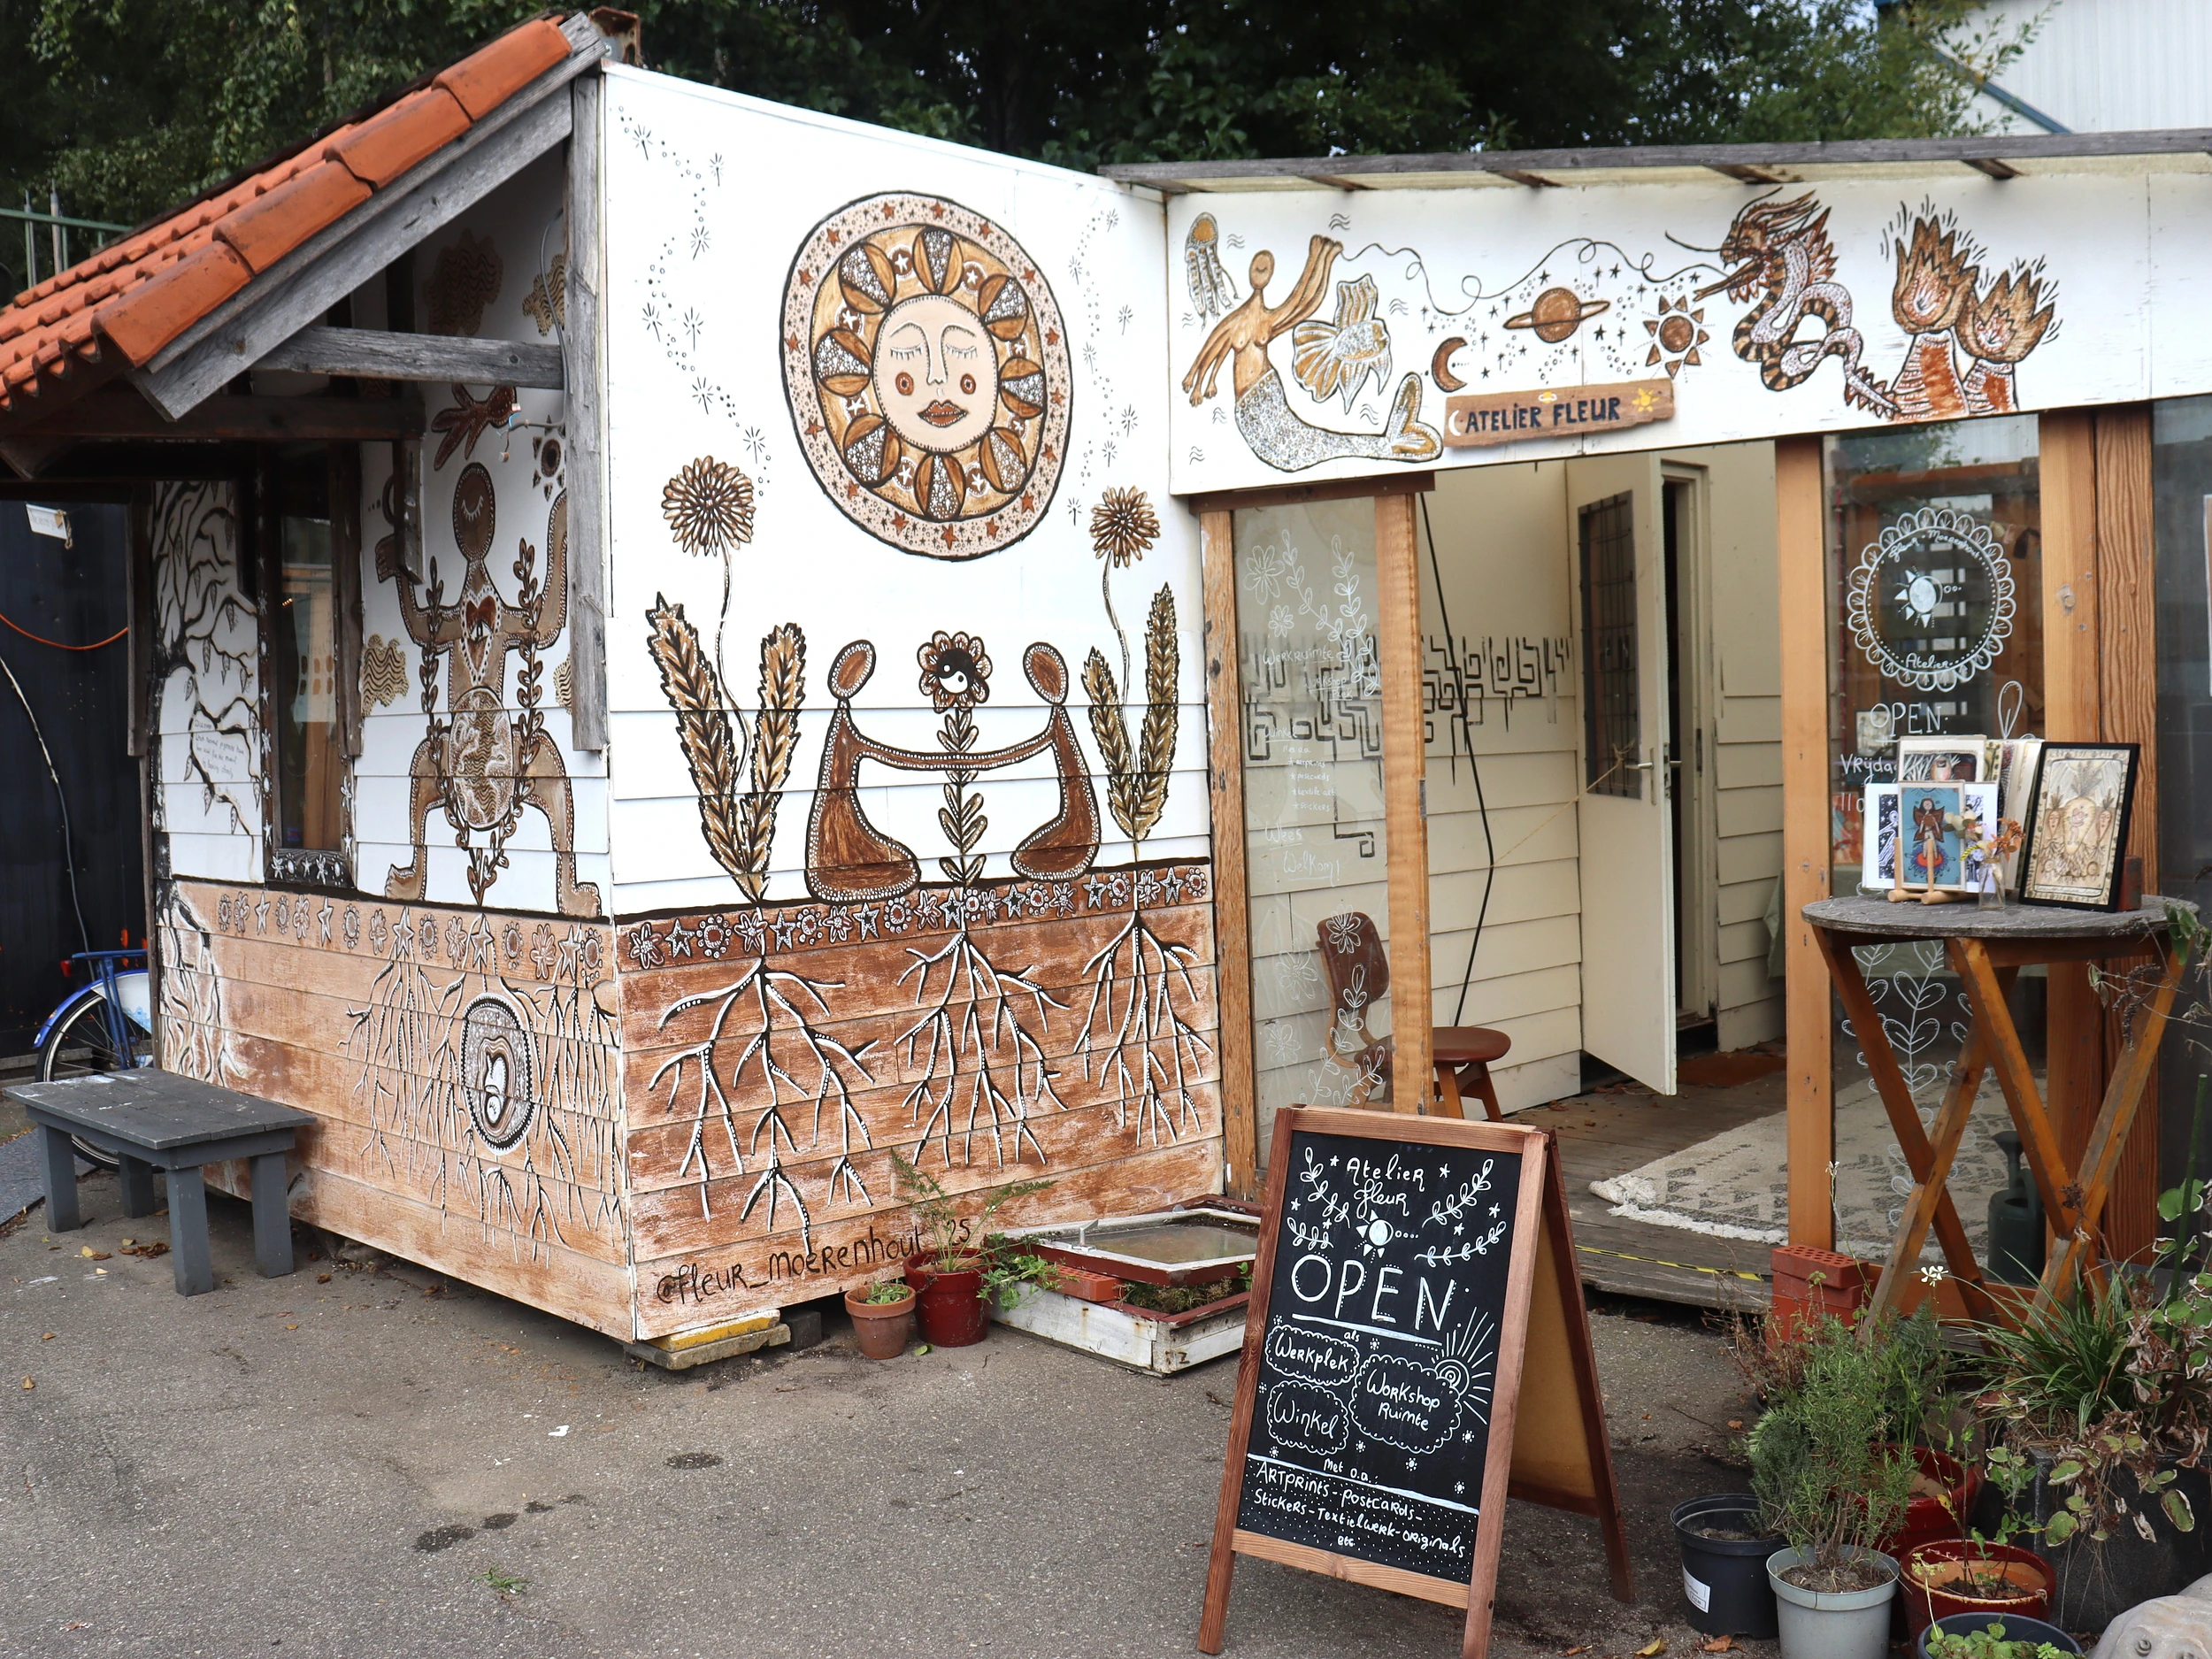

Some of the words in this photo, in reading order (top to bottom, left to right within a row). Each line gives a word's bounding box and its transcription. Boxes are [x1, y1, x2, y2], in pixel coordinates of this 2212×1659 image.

[1465, 403, 1541, 434] ATELIER
[1553, 397, 1621, 426] FLEUR
[1264, 815, 1302, 843] Wees
[1344, 1330, 1360, 1342] als
[1274, 1392, 1339, 1440] Winkel
[1378, 1402, 1430, 1432] Ruimte
